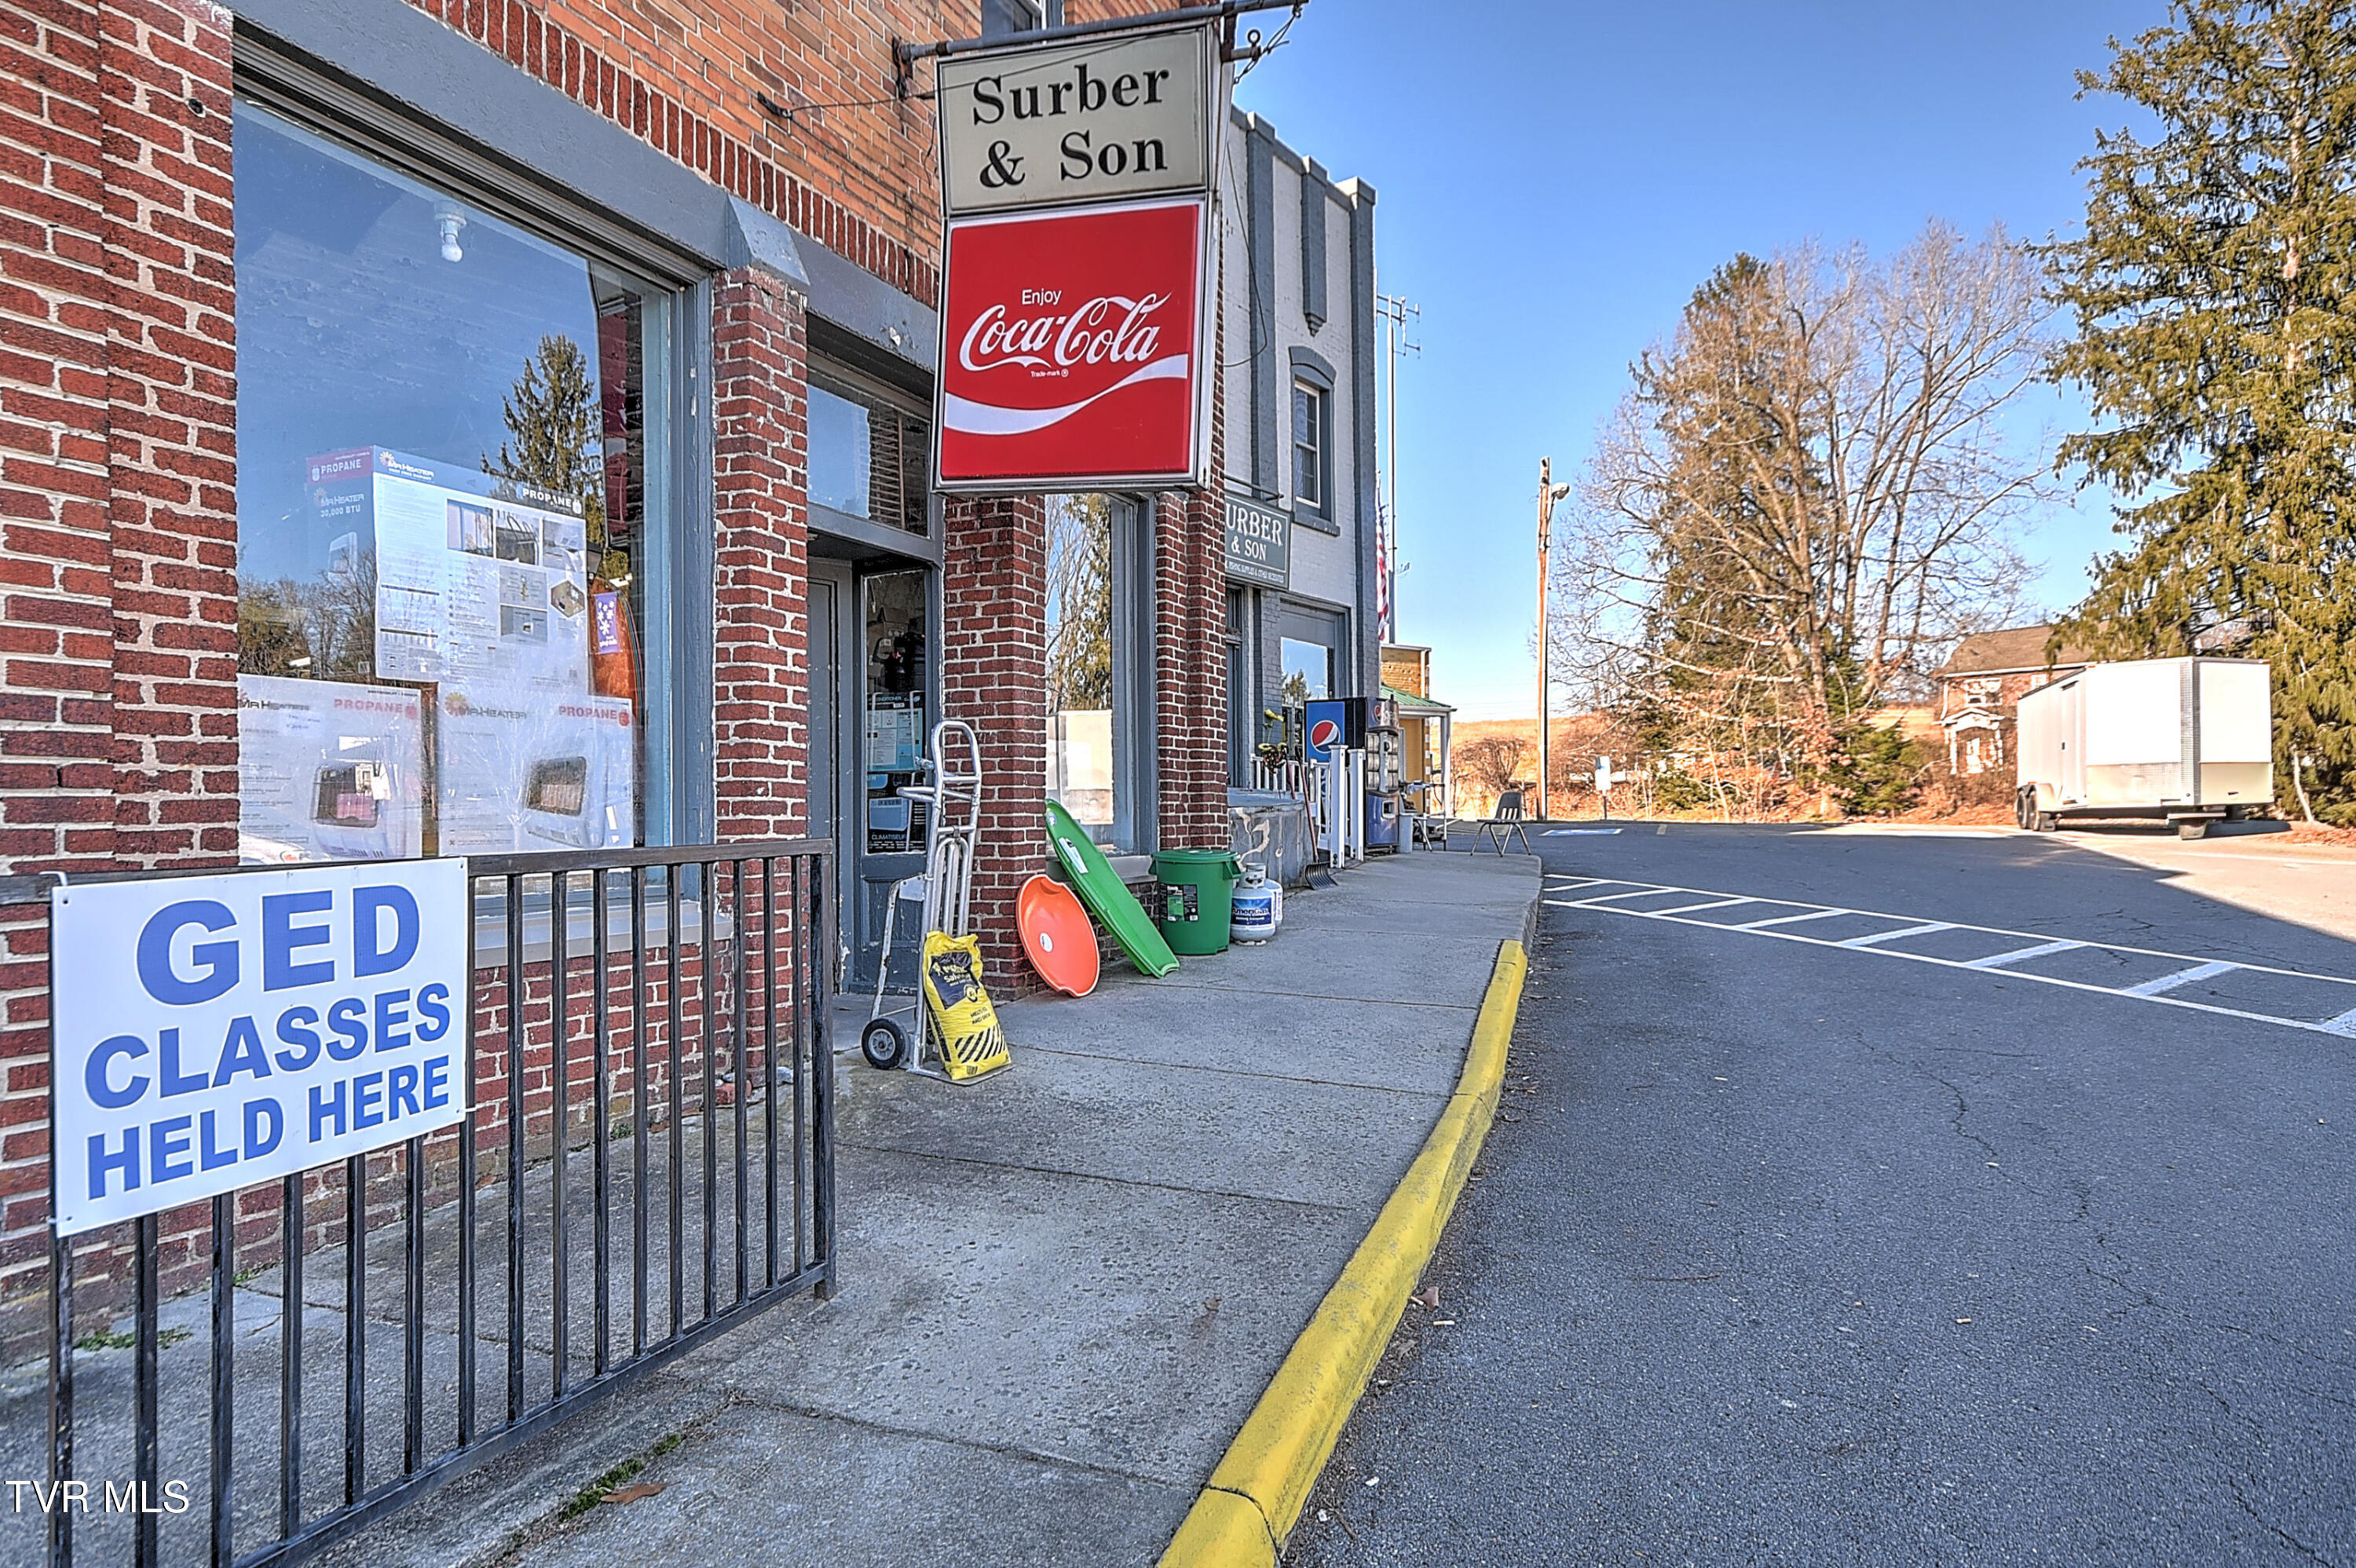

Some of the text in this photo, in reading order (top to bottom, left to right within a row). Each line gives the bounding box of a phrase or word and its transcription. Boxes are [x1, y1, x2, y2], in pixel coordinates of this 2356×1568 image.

[973, 64, 1169, 126] Surber
[979, 130, 1169, 189] & Son
[1022, 288, 1062, 307] Enjoy
[959, 291, 1173, 372] Coca-Cola
[321, 459, 361, 474] PROPANE
[346, 504, 361, 514] BTU
[522, 488, 573, 507] PROPANE
[1225, 503, 1283, 546] URBER
[1231, 535, 1267, 561] & SON
[334, 698, 403, 713] PROPANE
[558, 705, 618, 720] PROPANE
[137, 884, 421, 1006] GED
[84, 982, 451, 1109] CLASSES
[87, 1054, 450, 1201] HELD HERE
